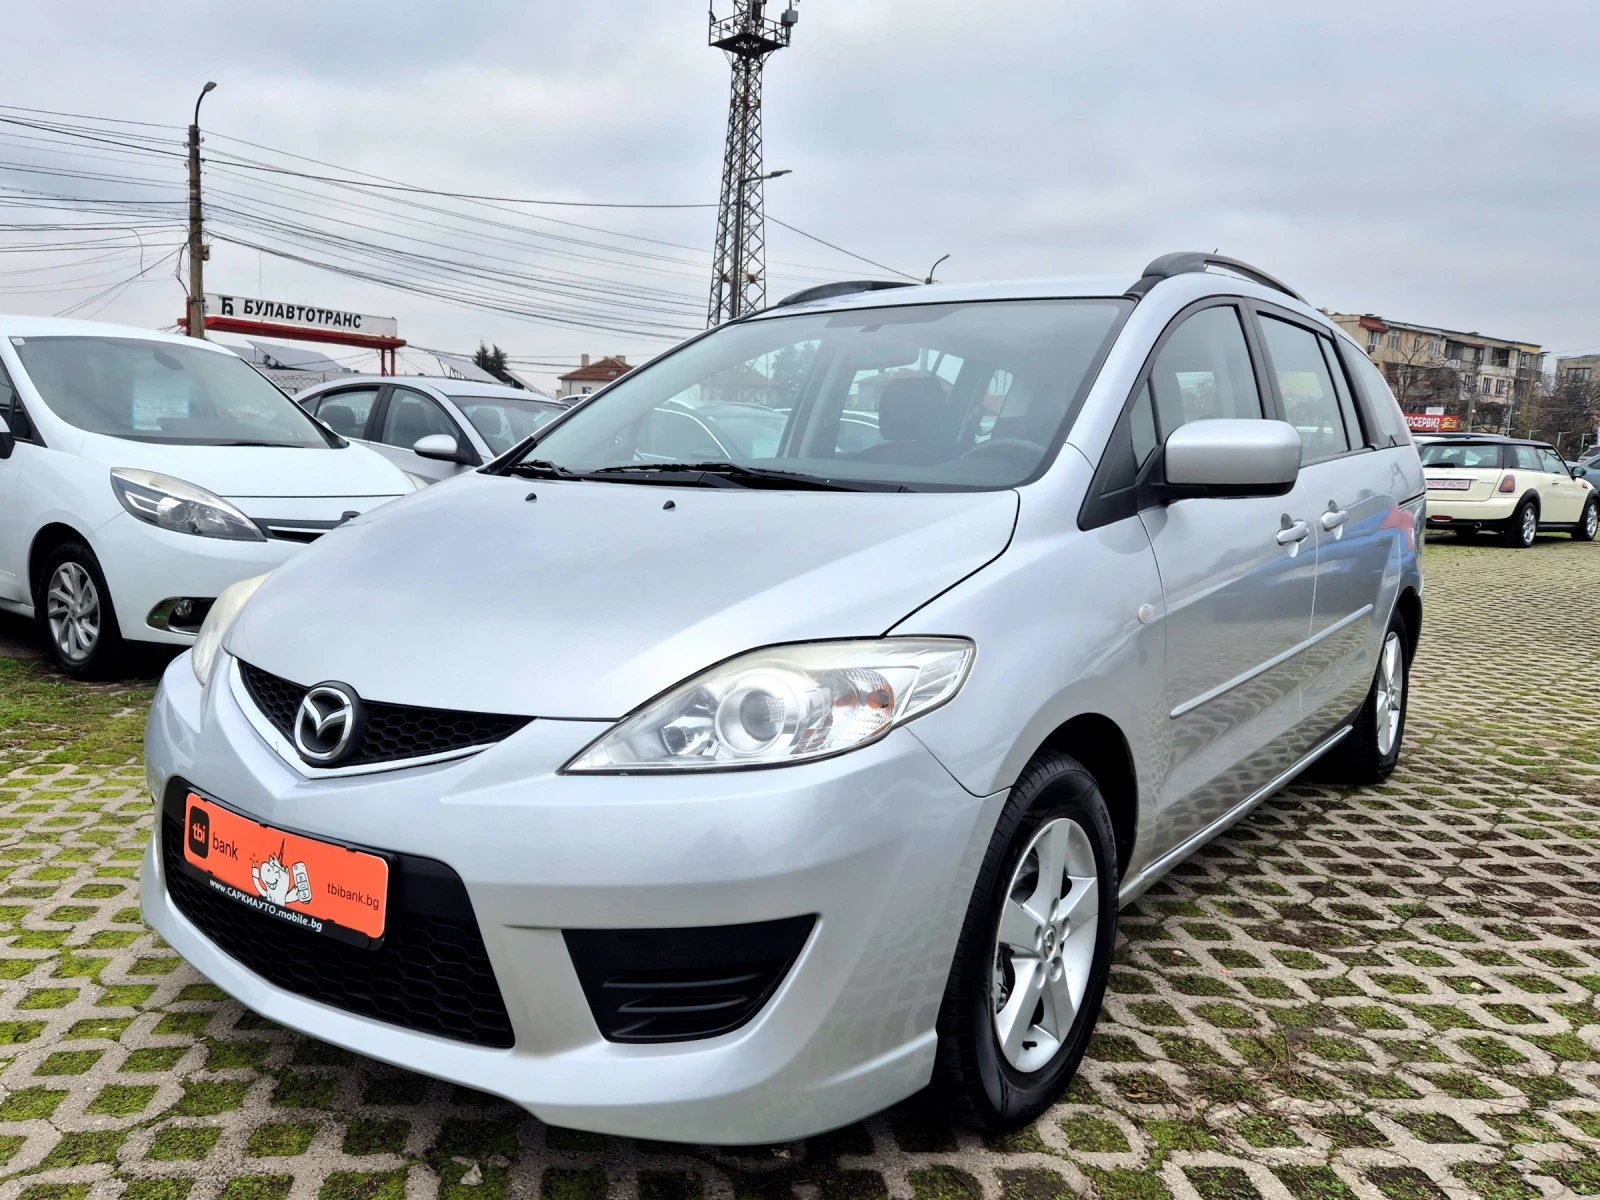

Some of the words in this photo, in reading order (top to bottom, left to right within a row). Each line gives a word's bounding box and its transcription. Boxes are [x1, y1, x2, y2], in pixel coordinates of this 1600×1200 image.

[243, 299, 362, 329] БУЛАВТОТРАНС
[192, 823, 206, 844] tbi
[212, 832, 239, 861] bank
[327, 883, 379, 911] tbibank.bg
